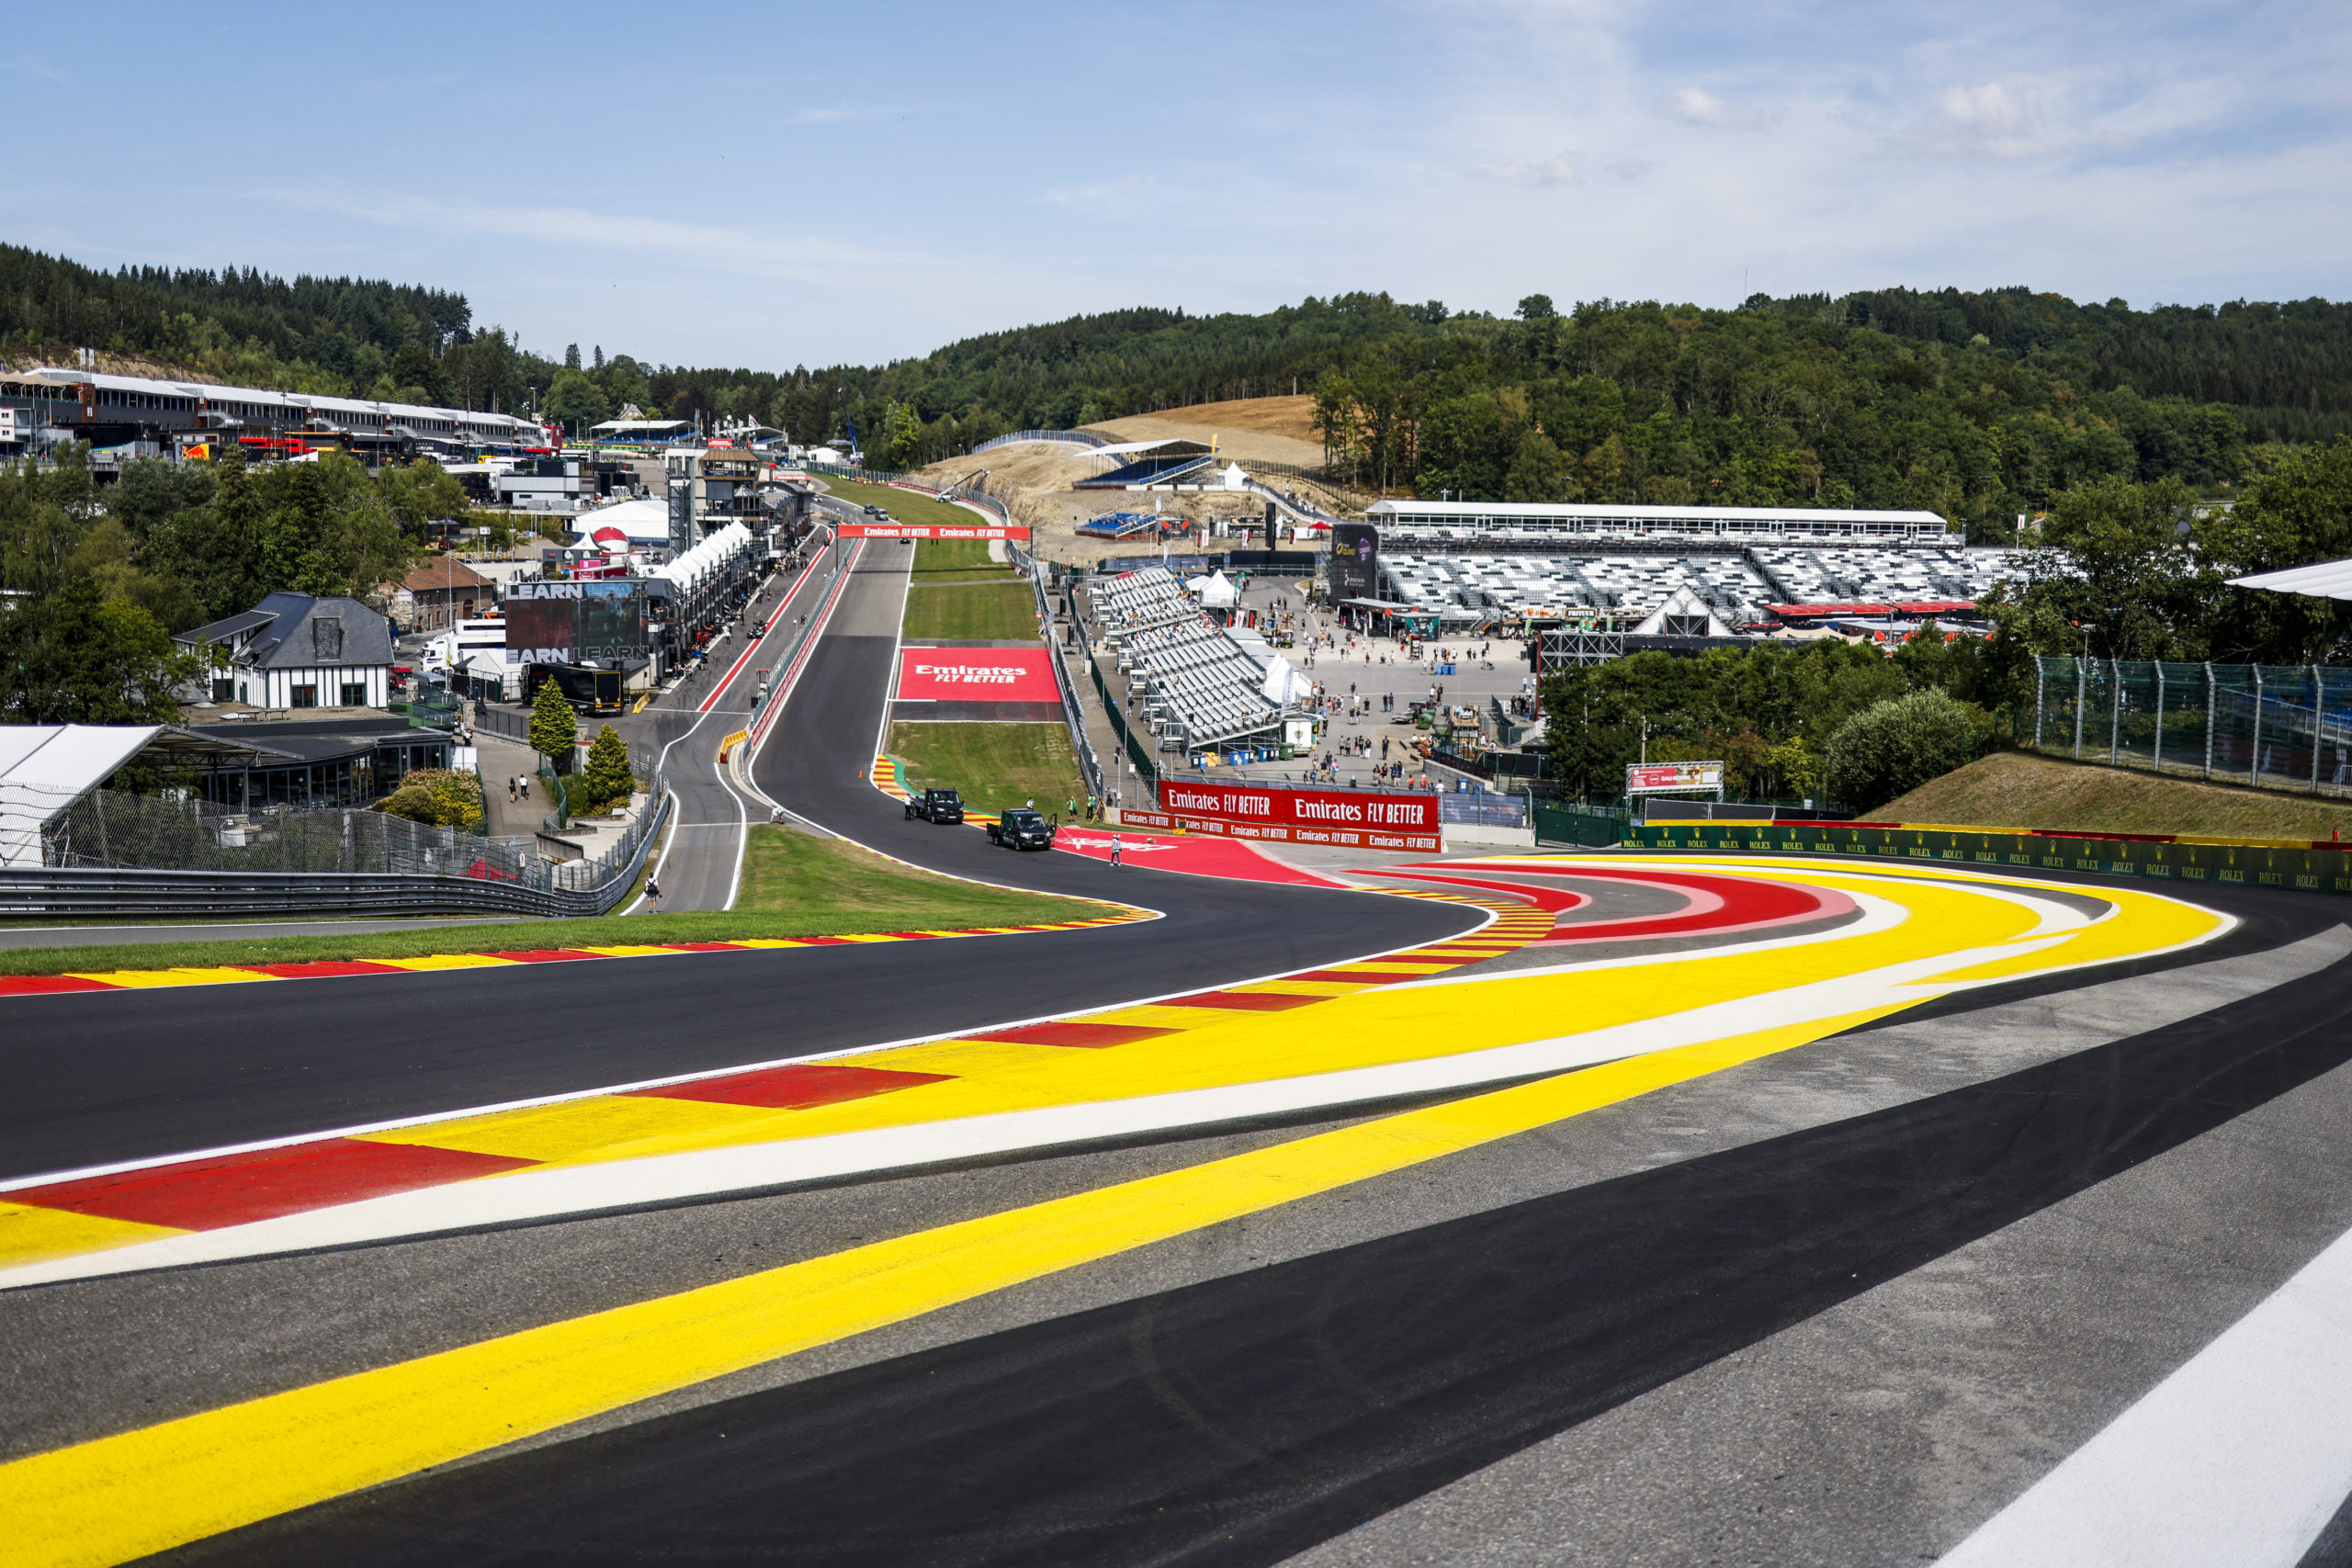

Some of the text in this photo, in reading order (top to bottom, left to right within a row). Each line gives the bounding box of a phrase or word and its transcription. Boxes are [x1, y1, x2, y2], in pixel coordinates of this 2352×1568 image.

[864, 527, 931, 536] Emirates FLY BETTER
[939, 528, 1006, 537] Emirates FLY BETTER
[505, 583, 582, 599] LEARN
[573, 645, 650, 662] LEARN
[914, 664, 1027, 675] Emirates
[934, 674, 1016, 684] FLY BETTER
[1168, 788, 1271, 816] Emirates FLY BETTER
[1295, 798, 1424, 825] Emirates FLY BETTER
[1124, 813, 1148, 825] Emirates
[1155, 816, 1169, 827] BETTER
[1175, 818, 1201, 829] Erates
[1209, 822, 1224, 833] BETTER
[1230, 824, 1287, 840] Emirates FLY BETTER
[1296, 829, 1359, 844] Emirates FLY BETTER
[1369, 834, 1436, 850] Emirates FLY BETTER
[1720, 840, 1739, 849] ROLEX
[1749, 841, 1770, 850] ROLEX
[1782, 842, 1804, 851] ROLEX
[1815, 843, 1836, 852] ROLEX
[1846, 844, 1866, 853] ROLEX
[1878, 846, 1898, 855] ROLEX
[1909, 847, 1930, 857] ROLEX
[1942, 850, 1963, 860] ROLEX
[1975, 852, 1996, 862] ROLEX
[2009, 853, 2030, 864] ROLEX
[2042, 856, 2064, 868] ROLEX
[2076, 859, 2098, 870] ROLEX
[2112, 862, 2134, 873] ROLEX
[2146, 863, 2170, 875] ROLEX
[2181, 866, 2204, 879] ROLEX
[2220, 869, 2245, 882] ROLEX
[2258, 872, 2283, 885] ROLEX
[2296, 874, 2319, 888] ROLEX
